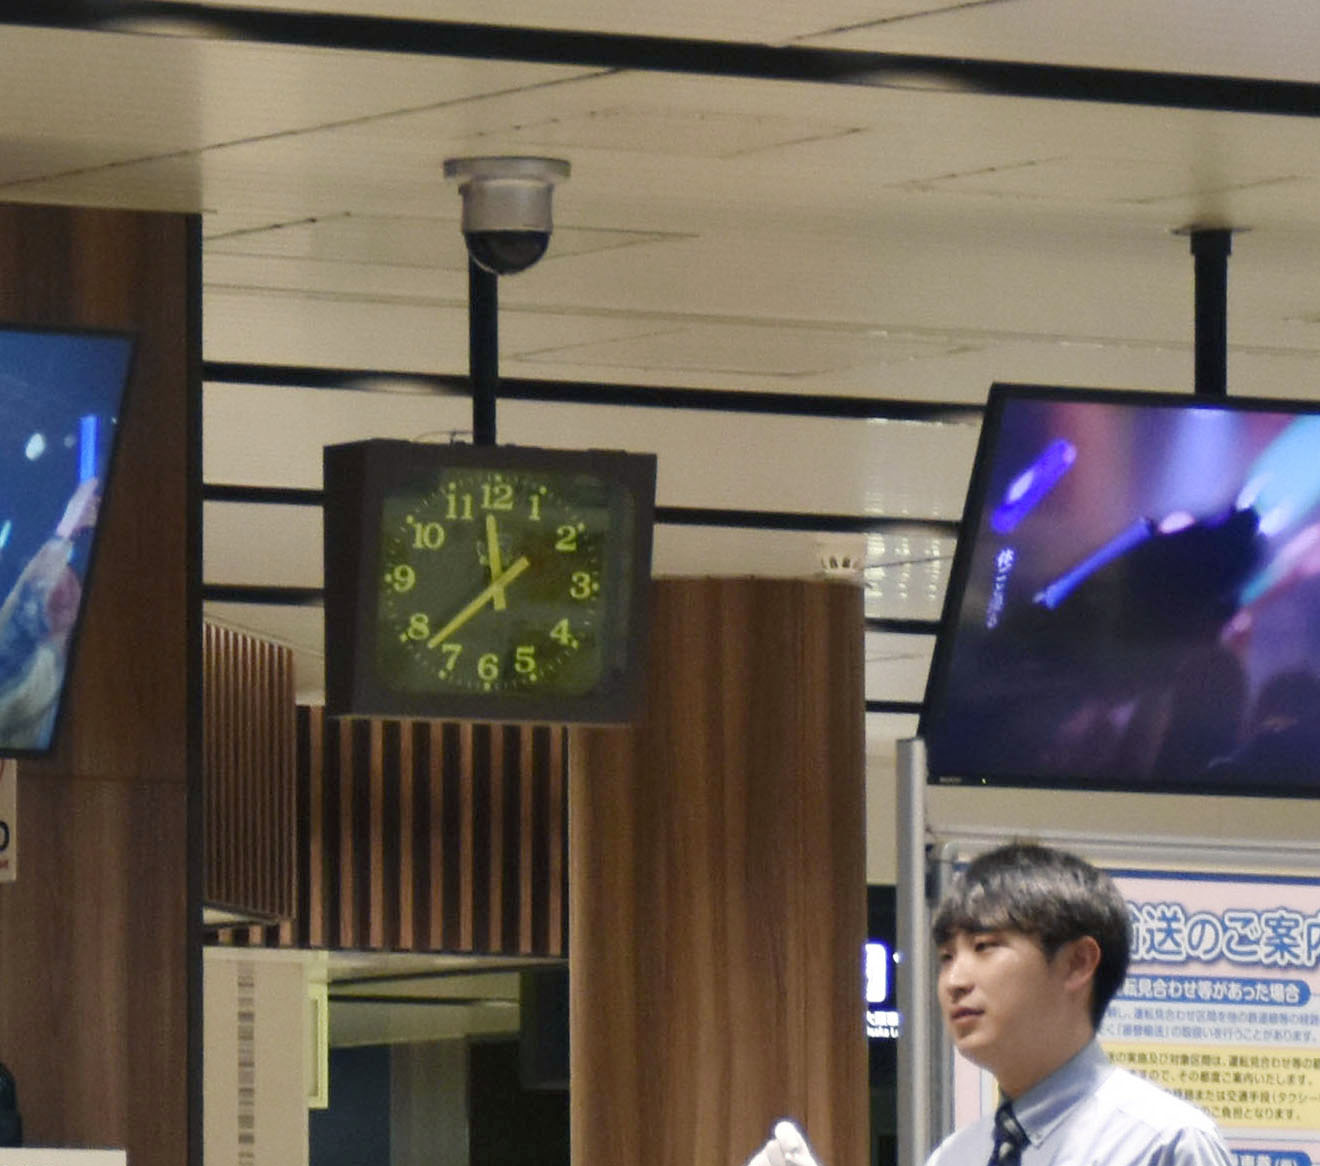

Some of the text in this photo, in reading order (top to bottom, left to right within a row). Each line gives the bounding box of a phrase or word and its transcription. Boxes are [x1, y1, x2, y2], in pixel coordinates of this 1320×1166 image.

[446, 494, 473, 521] 11
[481, 484, 513, 510] 12
[530, 495, 541, 521] 1
[412, 522, 445, 549] 10
[555, 525, 576, 551] 2
[393, 564, 416, 592] 9
[570, 571, 592, 599] 3
[408, 613, 429, 640] 8
[550, 619, 572, 645] 4
[441, 644, 463, 671] 7
[478, 654, 498, 680] 6
[514, 646, 536, 673] 5
